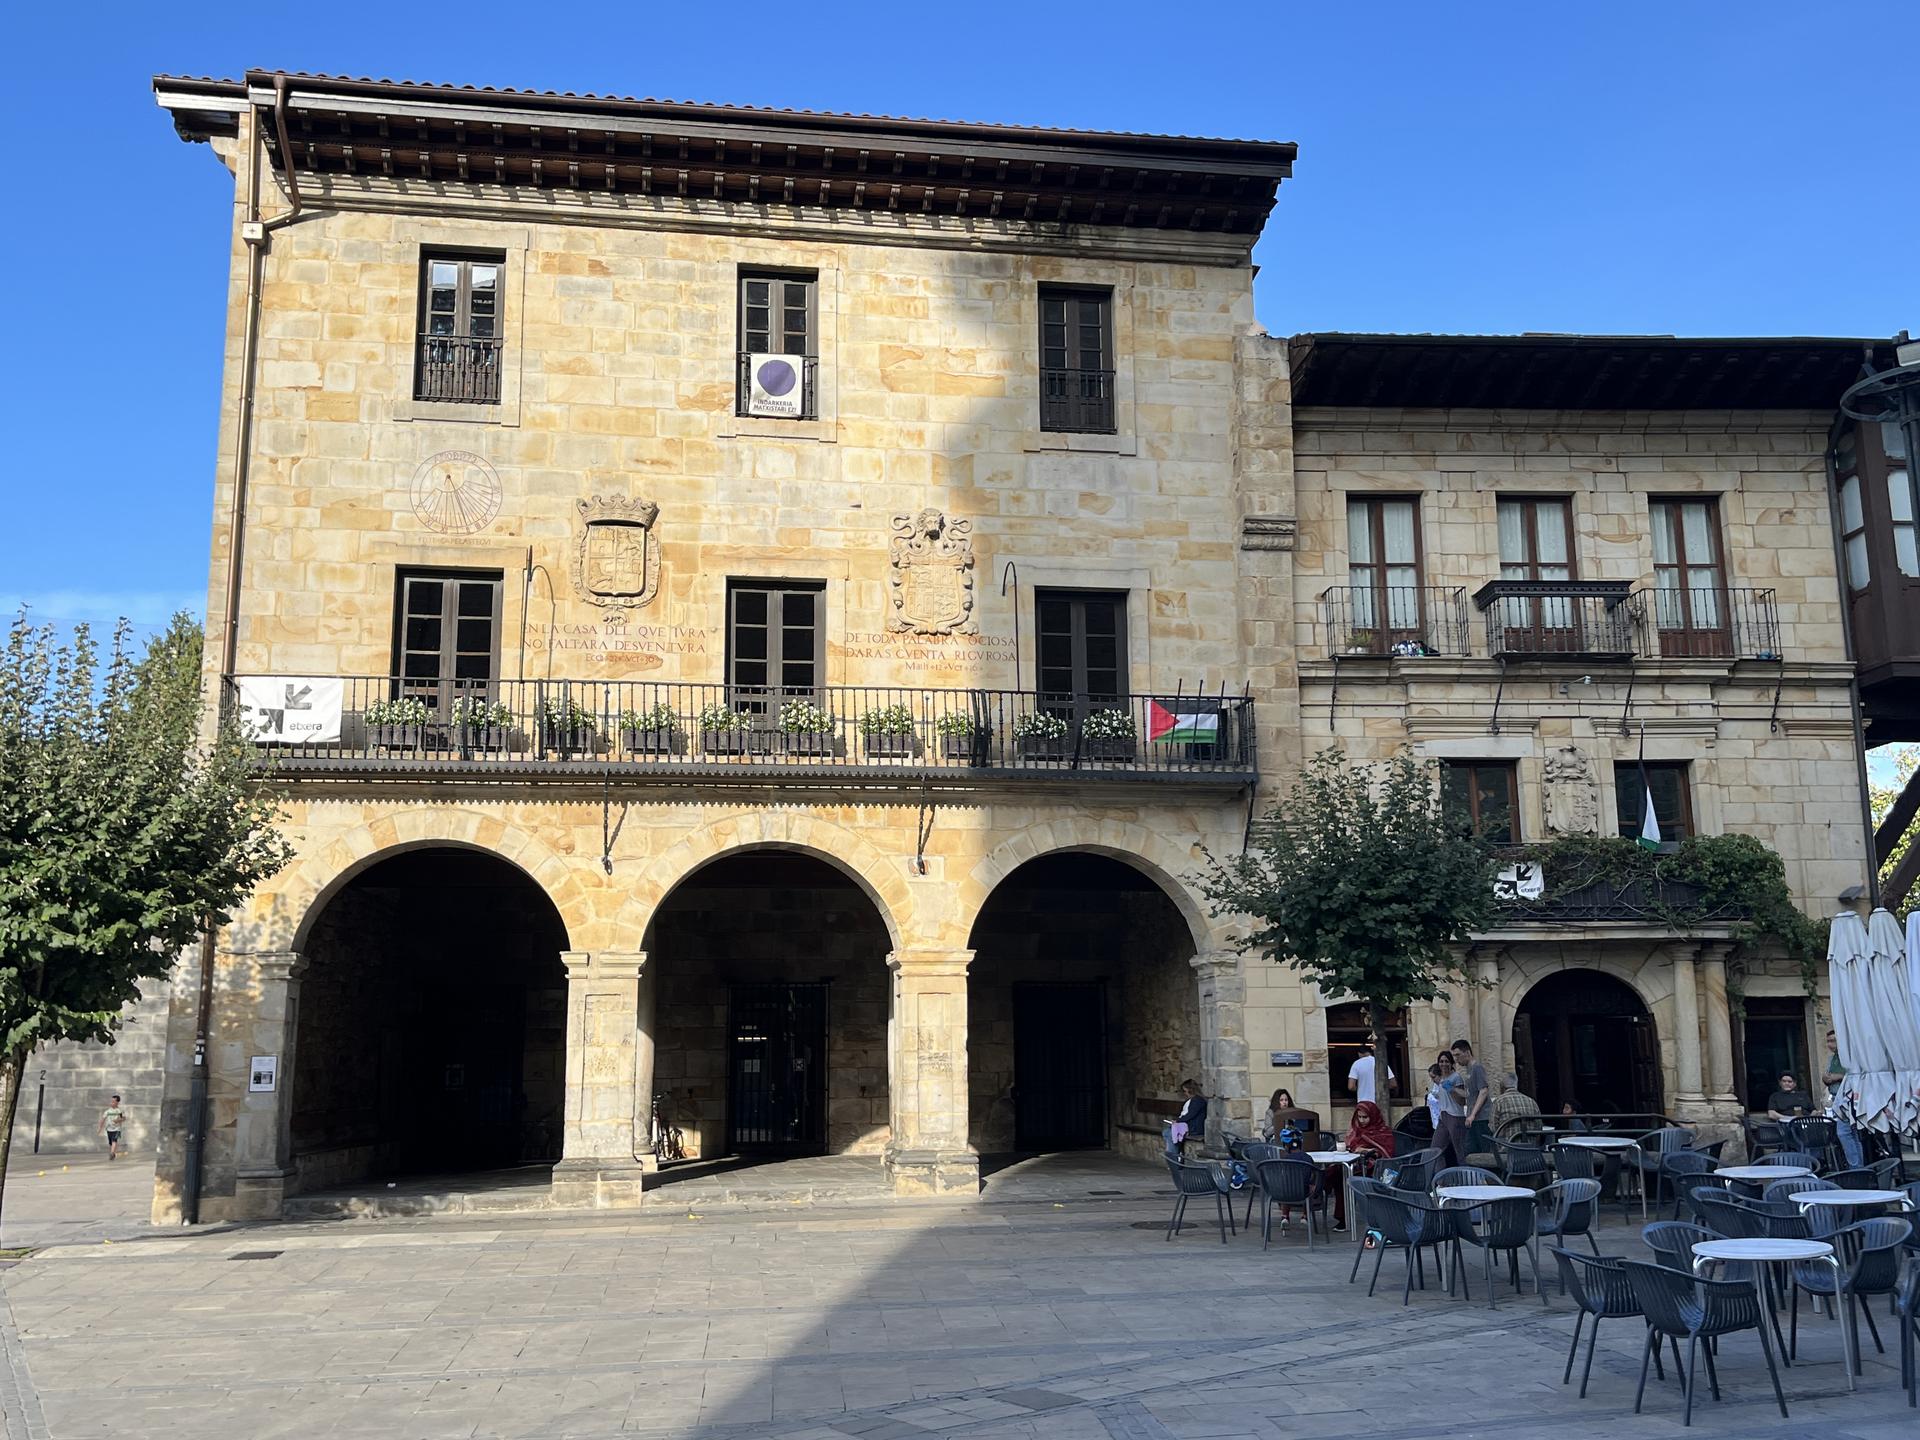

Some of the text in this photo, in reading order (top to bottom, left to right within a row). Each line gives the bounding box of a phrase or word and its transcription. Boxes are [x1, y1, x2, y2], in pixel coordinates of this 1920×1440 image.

[563, 624, 598, 635] CASA
[605, 625, 632, 636] DEL
[548, 639, 608, 650] FALTARA
[846, 632, 1016, 647] DE TODA PALABRA OCIOSA
[846, 647, 892, 659] DARAS
[289, 722, 323, 731] etxera
